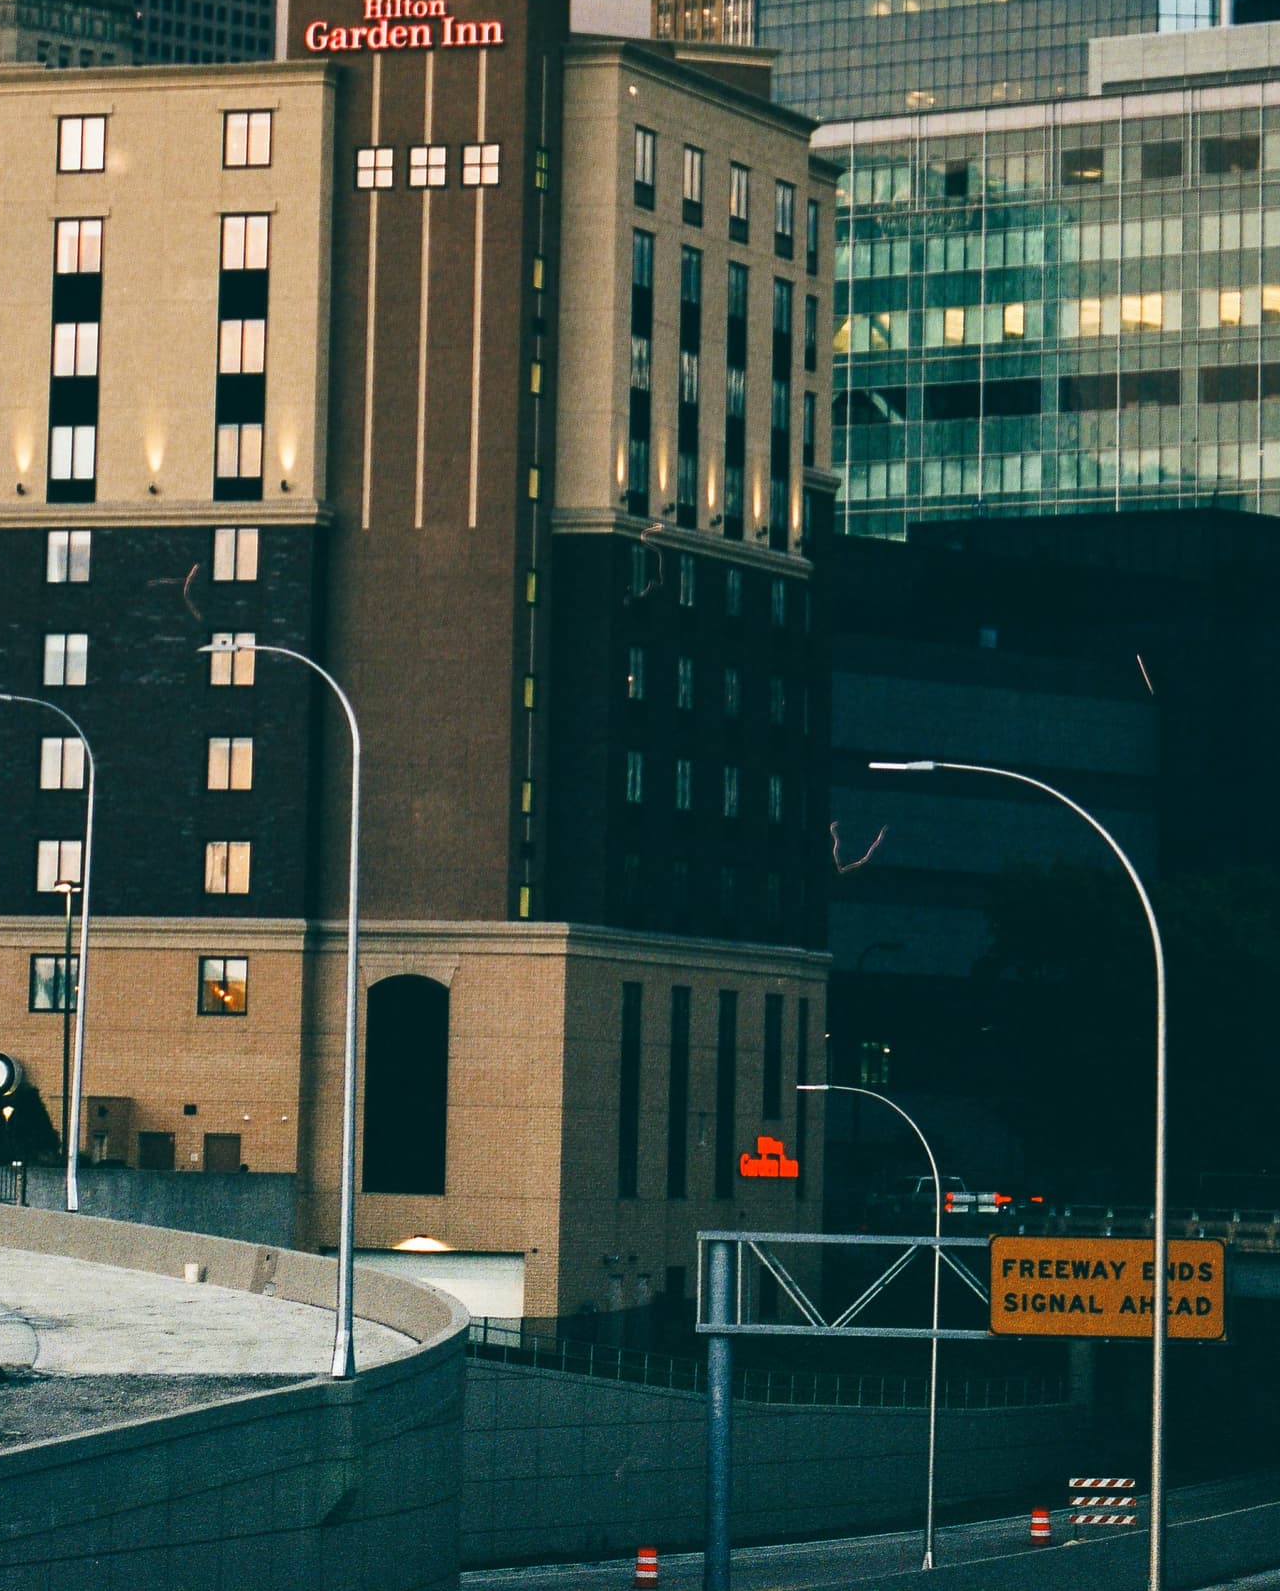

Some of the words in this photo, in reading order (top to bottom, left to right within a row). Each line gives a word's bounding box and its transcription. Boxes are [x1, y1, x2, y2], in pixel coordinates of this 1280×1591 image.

[305, 19, 432, 51] Garden
[441, 17, 503, 46] Inn
[1001, 1259, 1127, 1280] FREEWAY
[1003, 1293, 1104, 1314] SIGNAL
